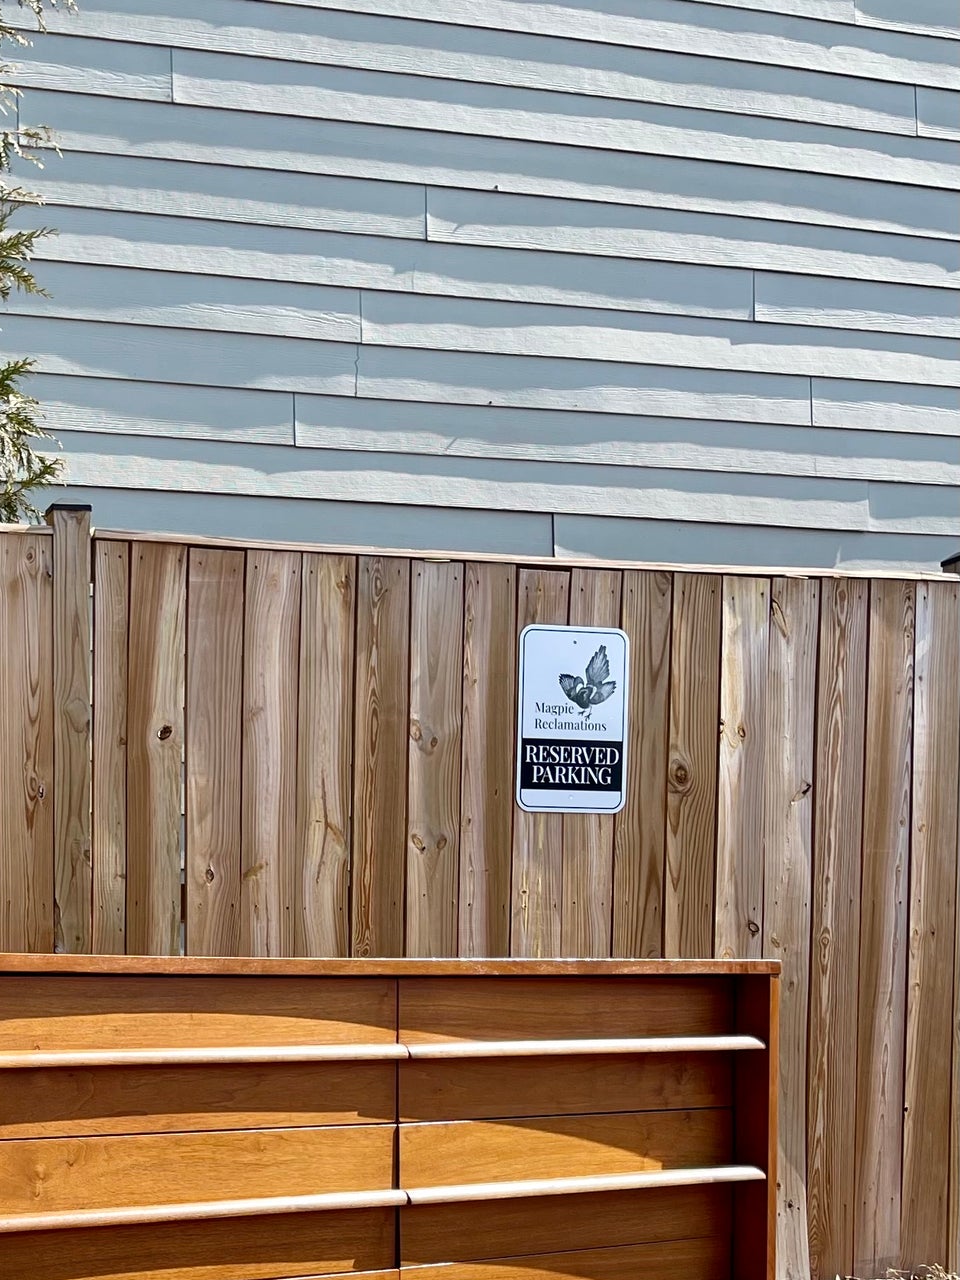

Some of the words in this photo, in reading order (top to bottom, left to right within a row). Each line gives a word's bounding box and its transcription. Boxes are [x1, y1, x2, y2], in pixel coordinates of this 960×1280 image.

[534, 702, 574, 716] Magpie
[534, 718, 607, 731] Reclamations
[525, 744, 619, 765] RESERVED
[532, 765, 612, 785] PARKING
